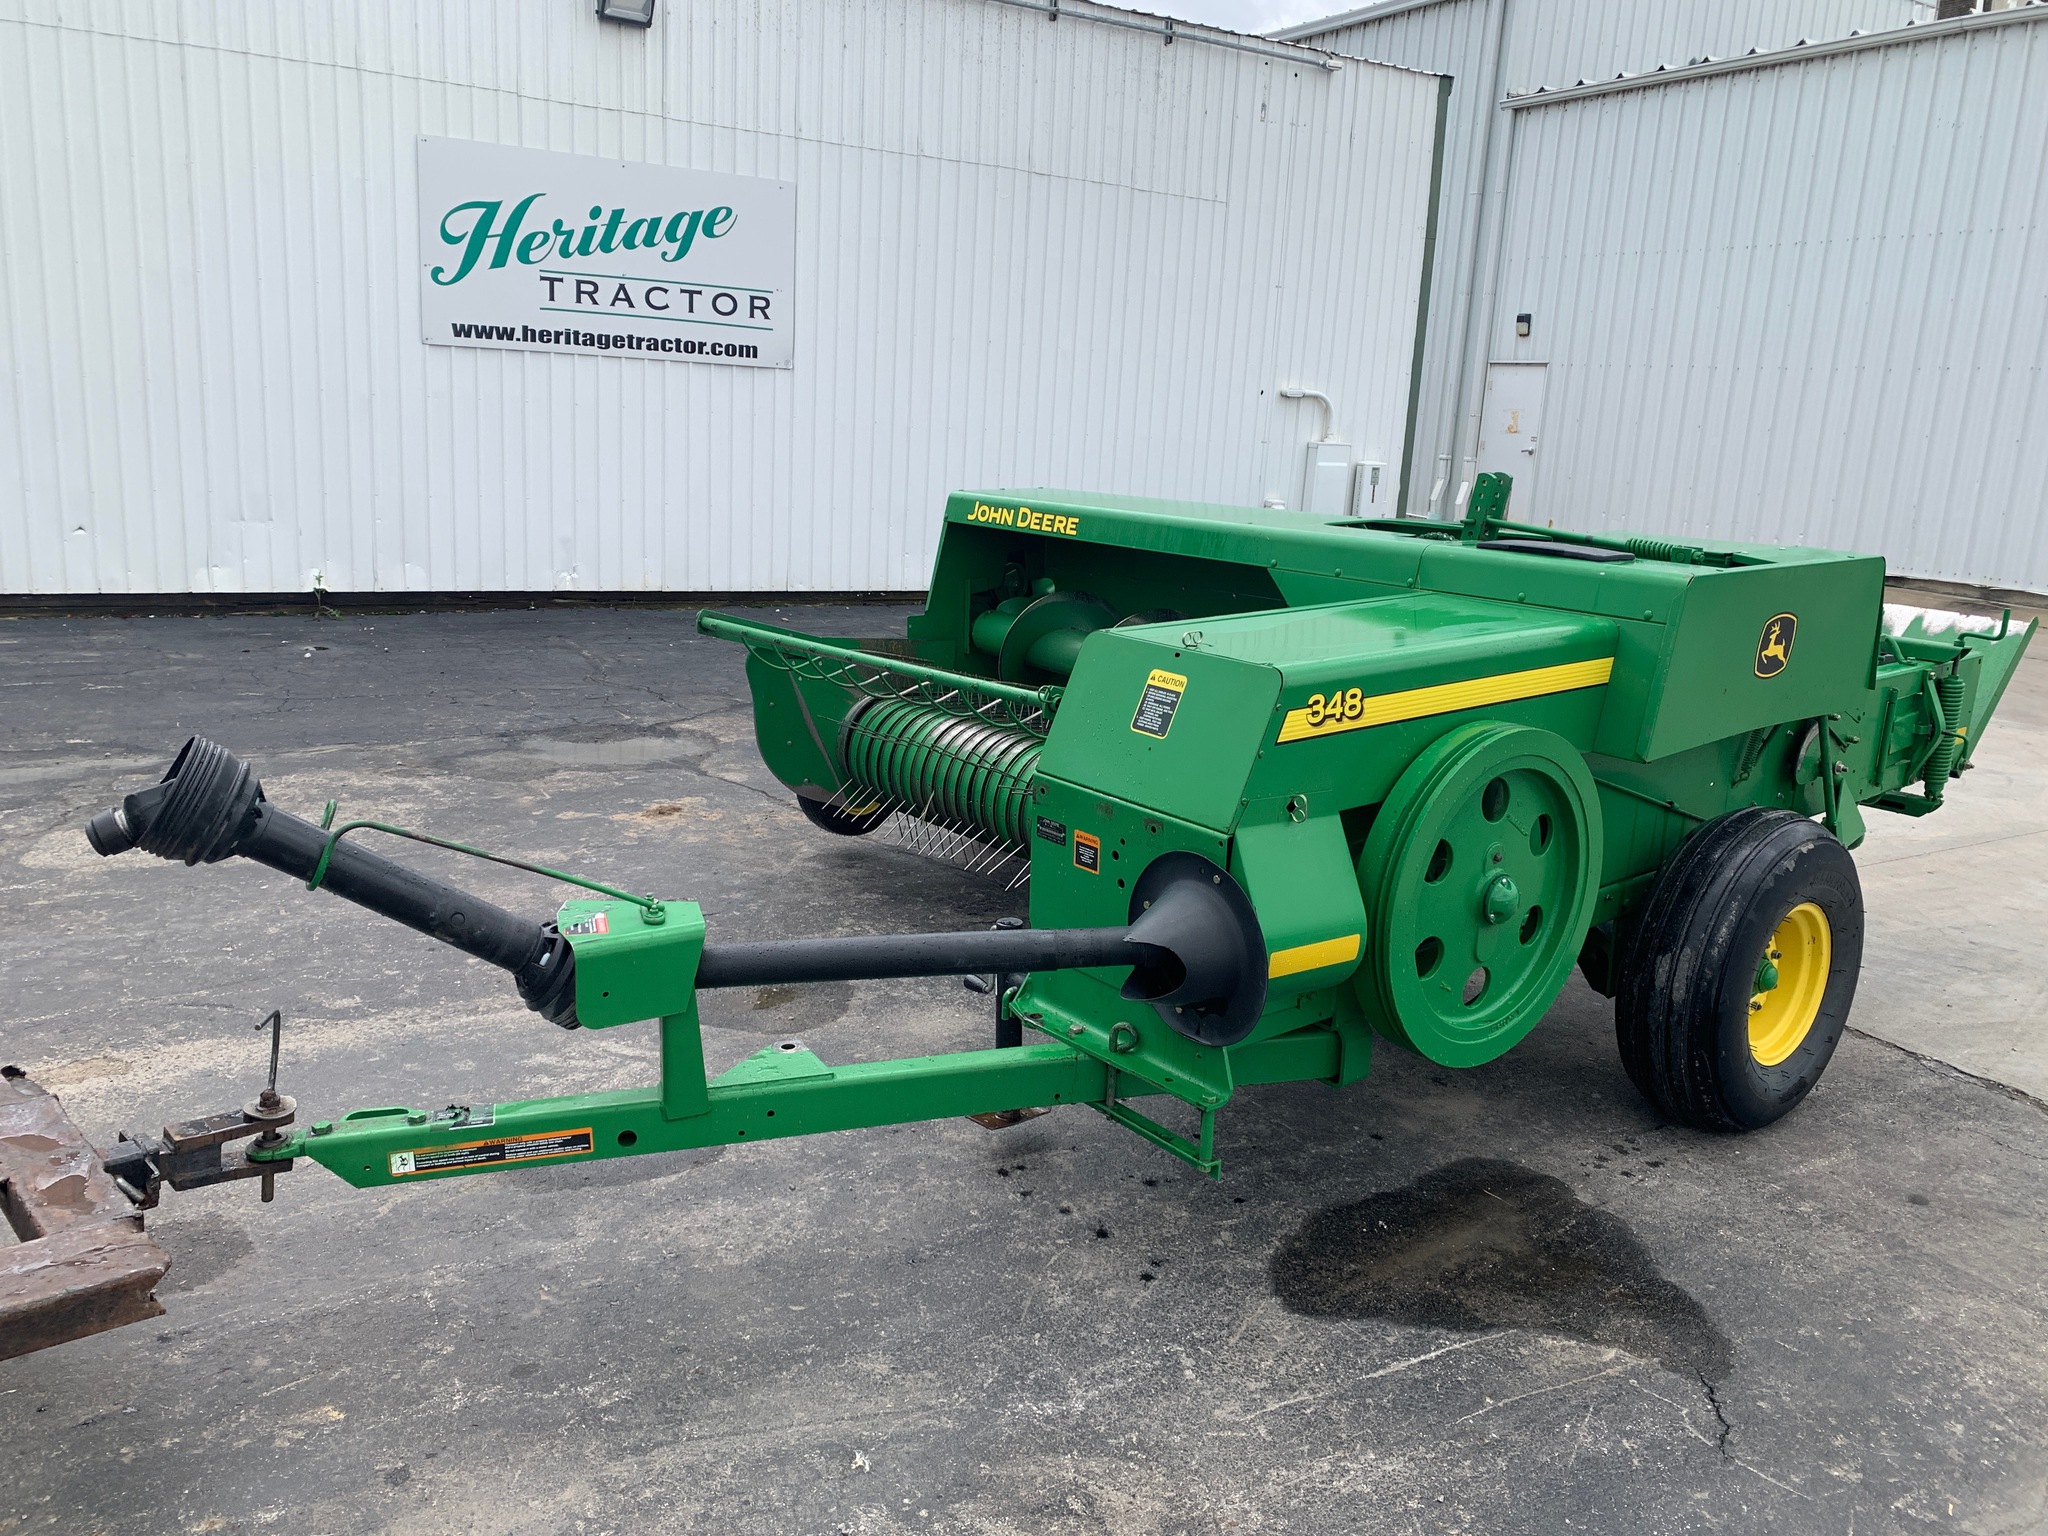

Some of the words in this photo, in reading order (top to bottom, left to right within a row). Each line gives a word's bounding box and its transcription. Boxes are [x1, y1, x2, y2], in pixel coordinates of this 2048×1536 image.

[430, 192, 738, 286] Heritage
[539, 274, 772, 320] TRACTOR
[451, 322, 758, 359] www.heritagetractor.com
[967, 501, 1014, 526] JOHN
[1016, 506, 1080, 536] DEERE
[1157, 675, 1186, 688] CAUTION
[1306, 687, 1363, 726] 348
[489, 1136, 523, 1145] WARNING
